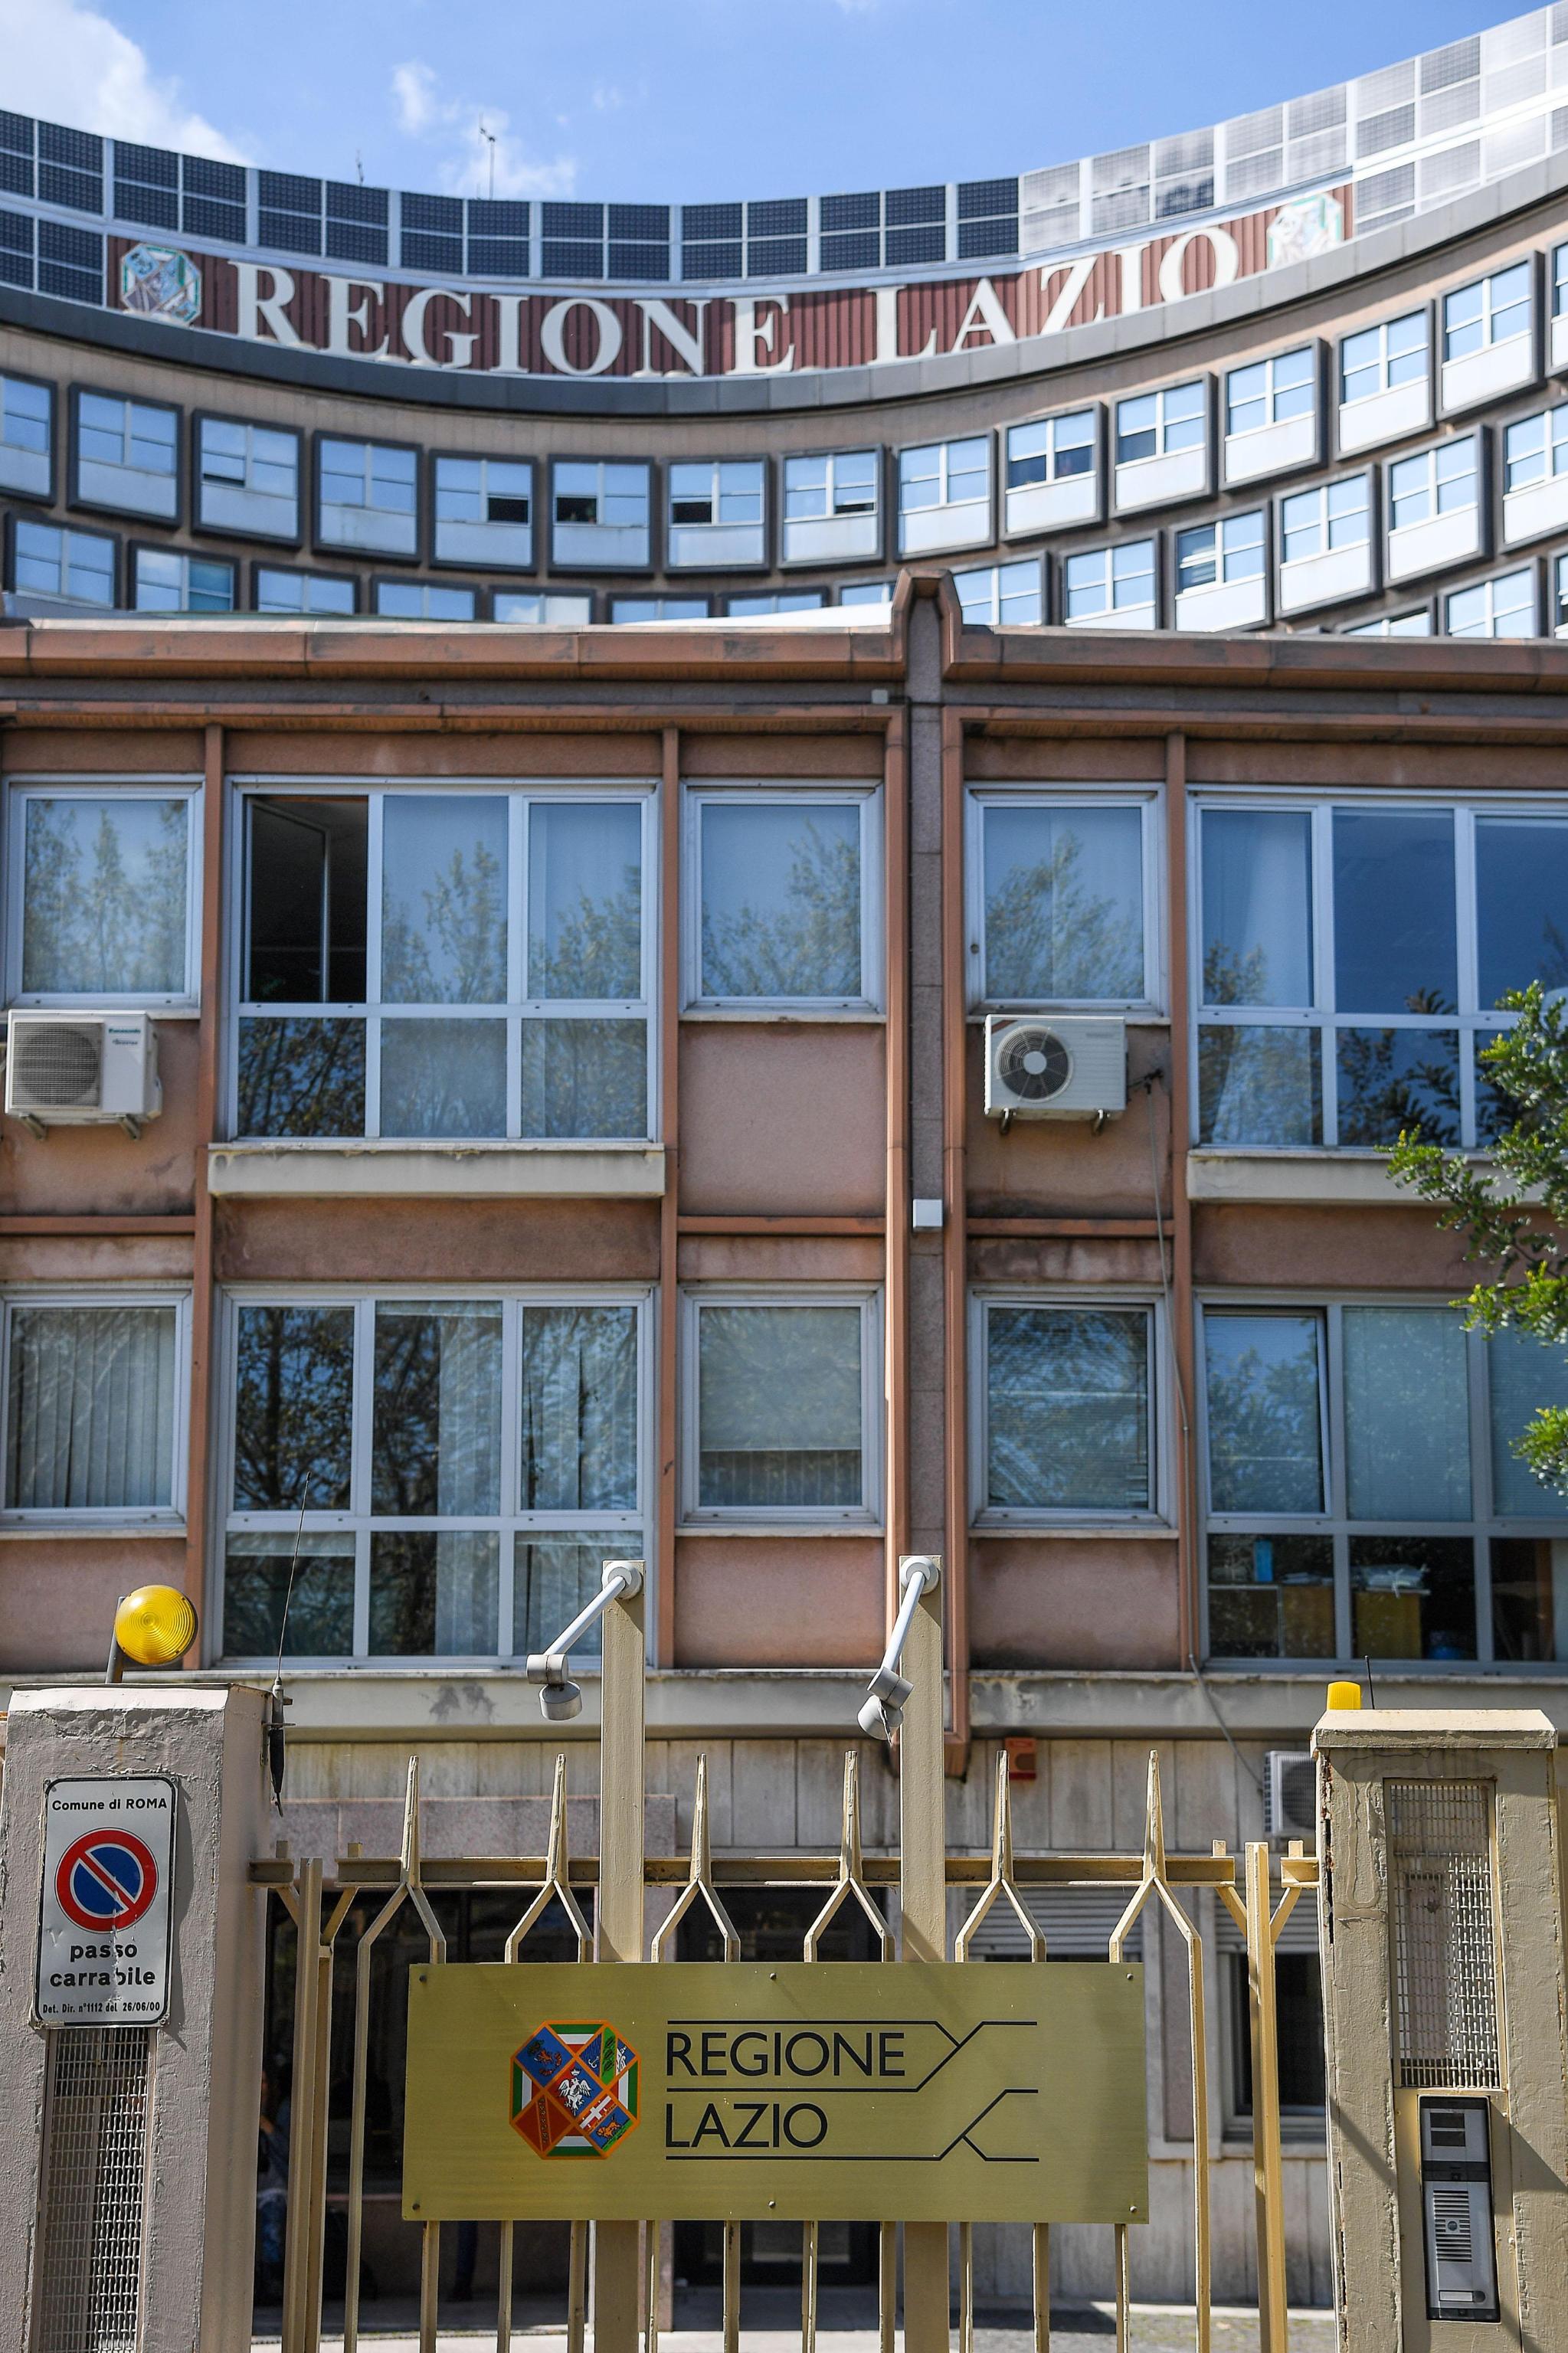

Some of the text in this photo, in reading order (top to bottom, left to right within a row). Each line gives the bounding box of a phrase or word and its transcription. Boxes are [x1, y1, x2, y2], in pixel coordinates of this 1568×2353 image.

[226, 226, 1240, 377] REGIONE LAZIO
[52, 1798, 167, 1811] Comune di ROMA
[70, 1944, 138, 1962] passo
[43, 2004, 58, 2014] Det.
[62, 2003, 76, 2013] Dir.
[106, 2002, 118, 2012] del
[123, 2001, 160, 2012] 26/06/00
[666, 2031, 905, 2077] REGIONE
[666, 2102, 828, 2148] LAZIO
